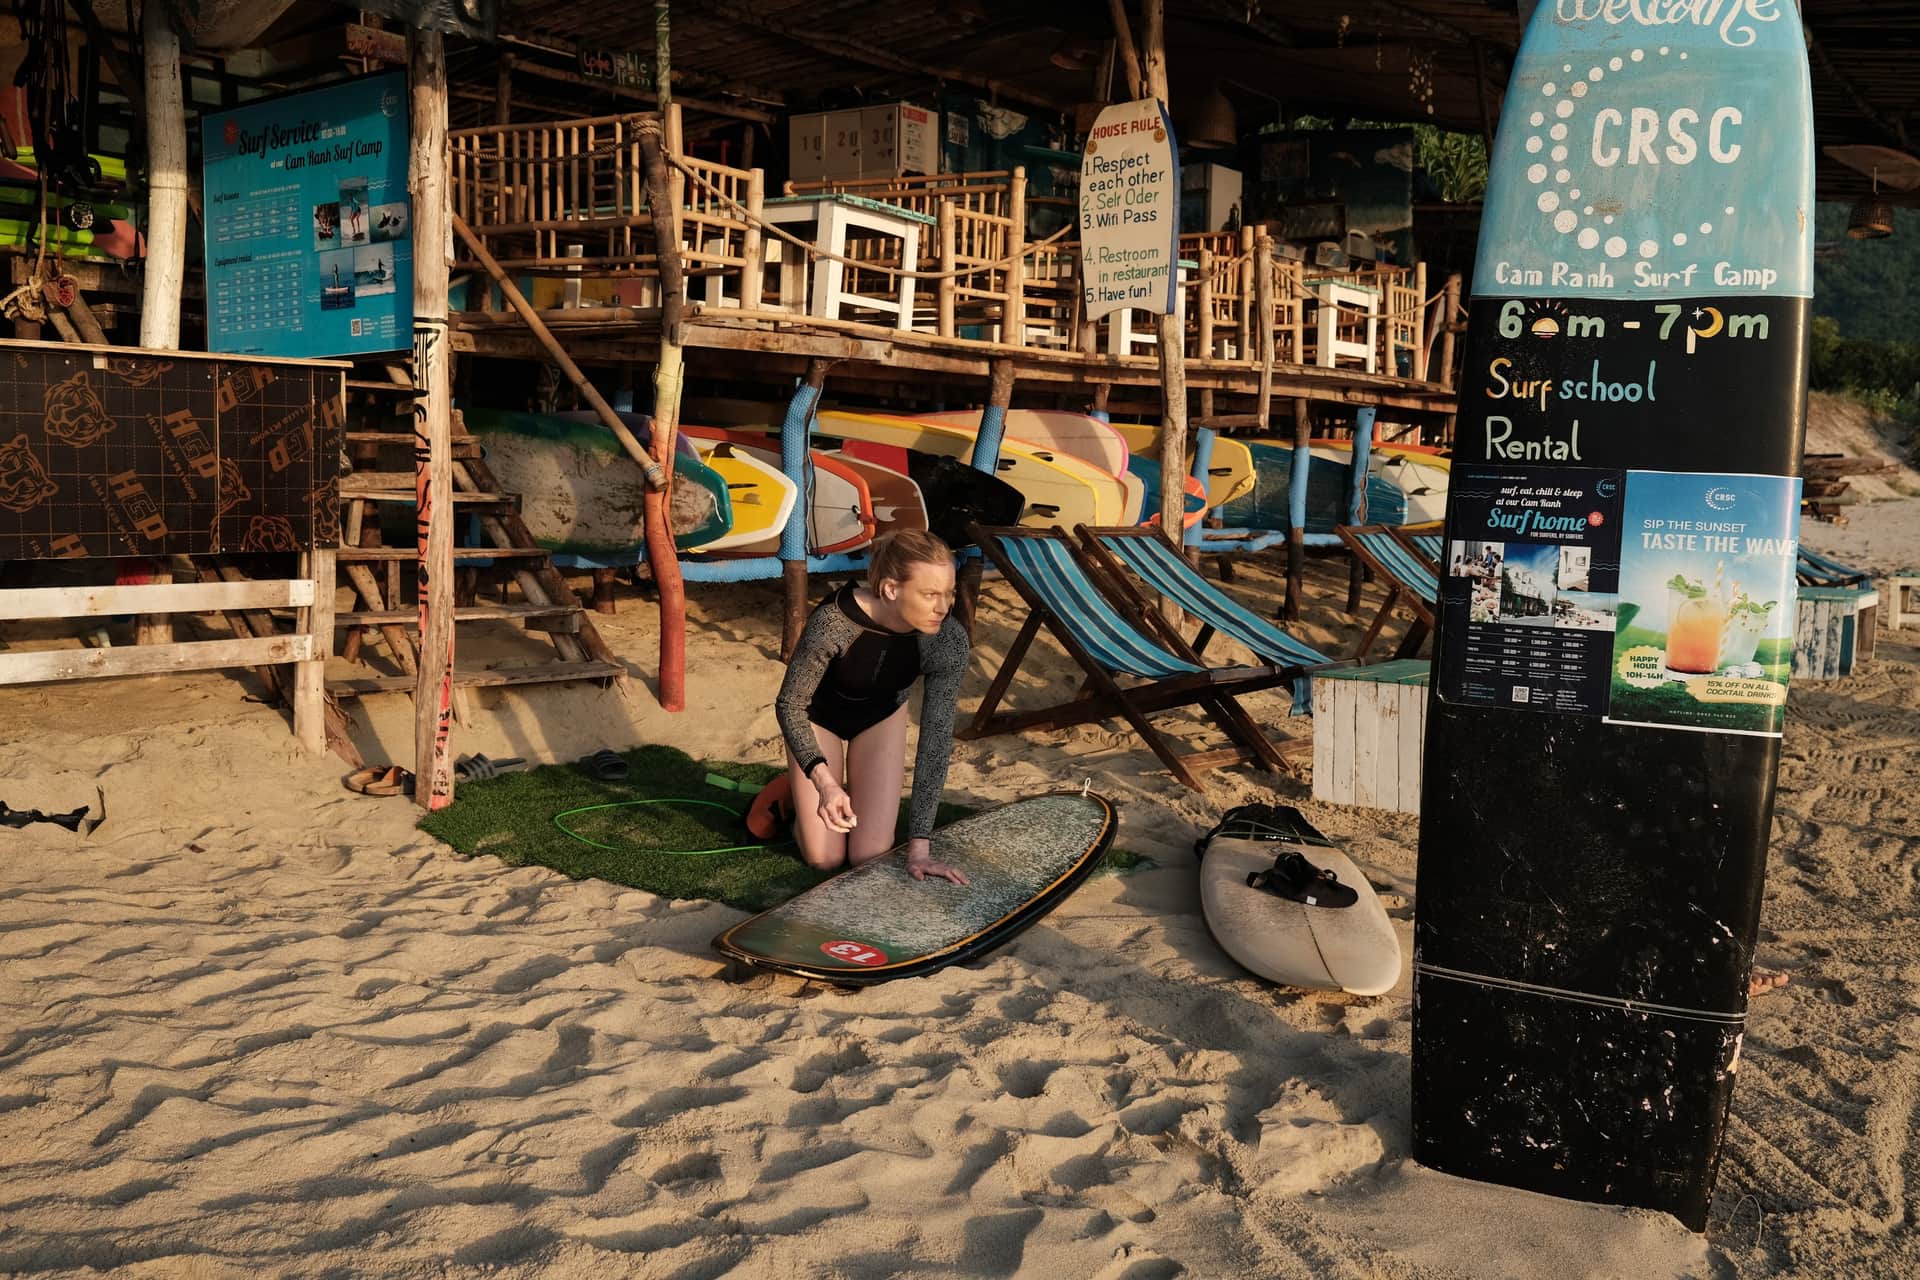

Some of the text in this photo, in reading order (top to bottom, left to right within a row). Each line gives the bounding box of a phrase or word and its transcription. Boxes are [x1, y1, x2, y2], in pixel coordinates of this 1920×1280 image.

[1093, 116, 1161, 140] HOUSE RULE
[1591, 106, 1743, 167] CRSC
[238, 126, 271, 159] Surf
[270, 120, 321, 150] Service
[285, 155, 305, 171] Cam
[306, 150, 332, 167] Ranh
[334, 144, 353, 163] Surf
[355, 139, 383, 159] Camp
[1093, 152, 1151, 175] Respect
[1089, 168, 1165, 192] each other
[1125, 187, 1159, 206] Oder
[1083, 209, 1157, 229] 3. Wifi Pass
[1099, 246, 1159, 264] Restroom
[1098, 264, 1169, 283] in restaurant
[1495, 261, 1777, 290] Cam Ranh Surf Camp
[1098, 286, 1126, 302] Have
[1128, 281, 1152, 298] fun!
[1486, 357, 1656, 412] Surf school
[1485, 415, 1583, 461] Rental
[1535, 487, 1553, 496] chill
[1554, 488, 1562, 496] &
[1562, 488, 1583, 499] sleep
[1714, 493, 1736, 502] CRSC
[1520, 498, 1538, 507] Cam
[1540, 499, 1562, 508] Ranh
[1487, 507, 1533, 535] Surf
[1532, 511, 1587, 532] home
[1643, 519, 1747, 533] SIP THE SUNSET
[1641, 532, 1698, 552] TASTE
[1703, 535, 1740, 553] THE
[1629, 655, 1660, 663] HAPPY
[1633, 662, 1657, 670] HOUR
[1626, 671, 1664, 680] 10H-14H
[1706, 688, 1745, 697] COCKTAIL
[1707, 680, 1723, 688] 15%
[1755, 683, 1770, 691] ALL
[829, 944, 877, 963] 13
